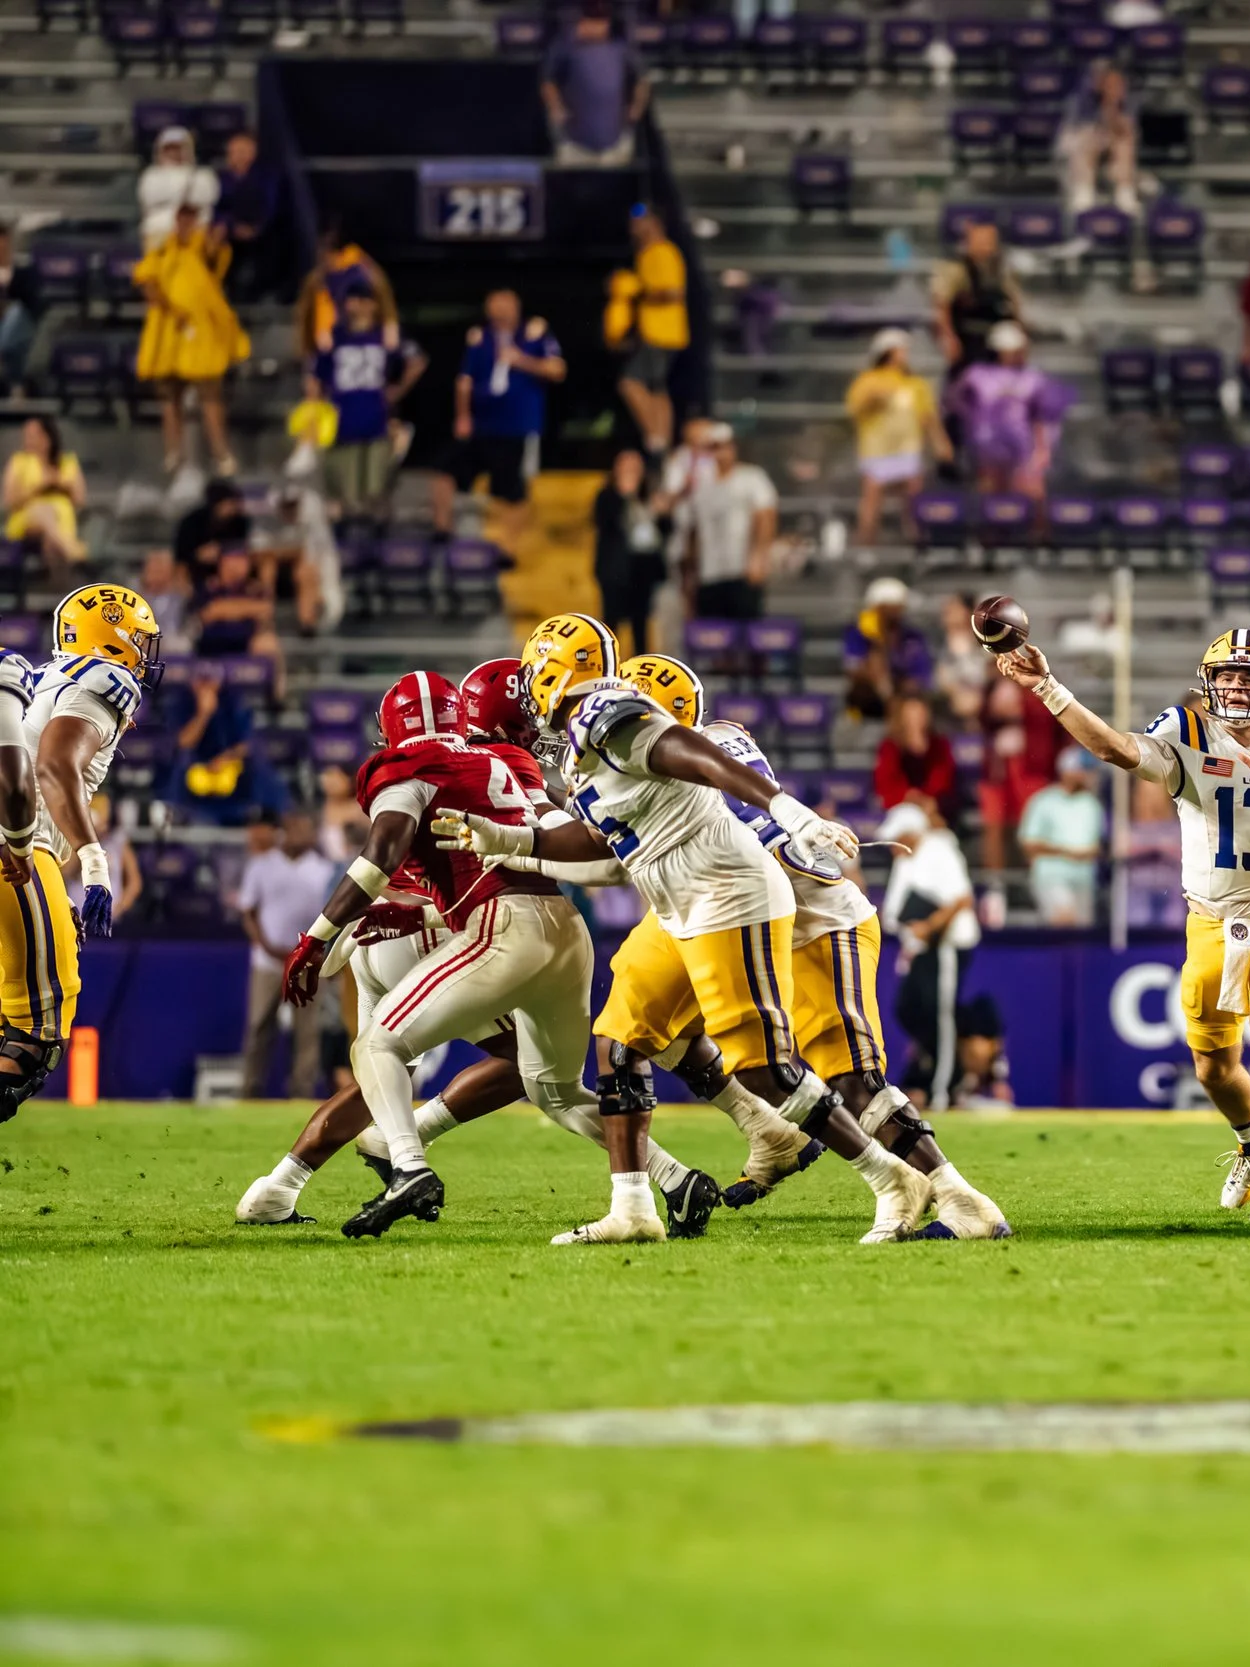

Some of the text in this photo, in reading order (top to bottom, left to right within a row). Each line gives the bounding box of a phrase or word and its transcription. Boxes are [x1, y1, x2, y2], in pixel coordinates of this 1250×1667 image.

[445, 187, 527, 235] 215
[78, 589, 137, 611] LSU
[529, 620, 579, 642] SU
